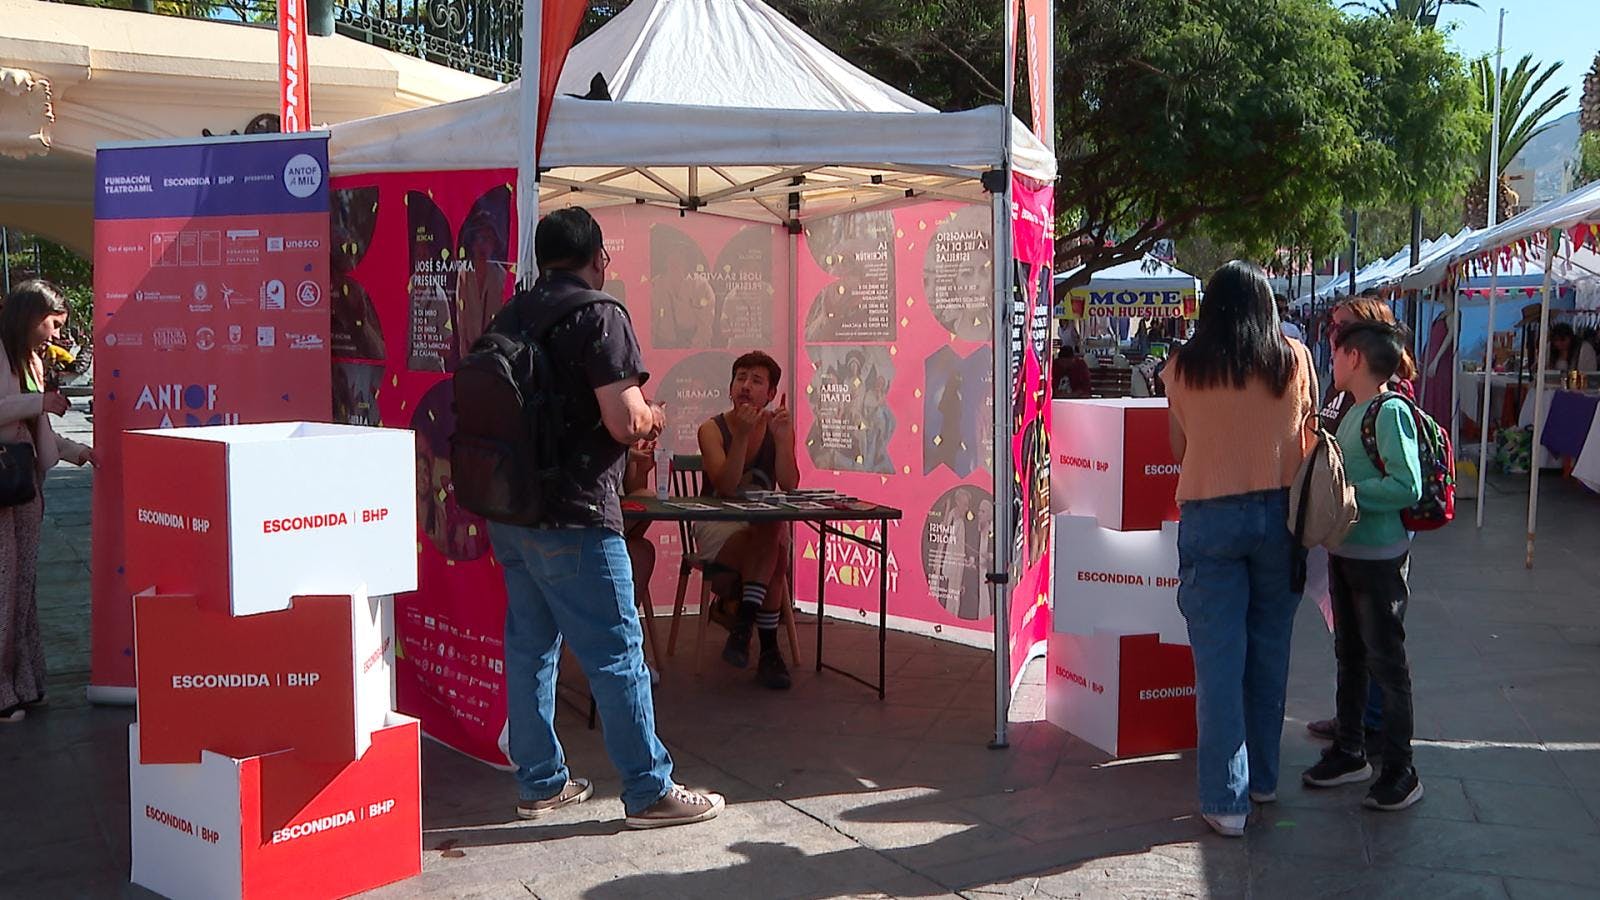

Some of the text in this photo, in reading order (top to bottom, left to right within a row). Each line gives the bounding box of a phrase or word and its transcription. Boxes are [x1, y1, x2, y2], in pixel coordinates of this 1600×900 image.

[289, 167, 317, 176] ANTOF
[104, 174, 150, 186] FUNDACIÓN
[163, 176, 235, 187] ESCONDIDA BHP
[297, 176, 316, 186] MIL
[104, 184, 153, 194] TEATROAMIL
[286, 240, 319, 248] unesco
[1088, 306, 1181, 318] CON HUESILLO
[1060, 454, 1108, 472] ESCONDIDA BHP
[138, 508, 210, 533] ESCONDIDA BHP
[263, 508, 388, 534] ESCONDIDA BHP
[1077, 571, 1179, 588] ESCONDIDA BHP
[172, 673, 320, 689] ESCONDIDA BHP
[1055, 665, 1104, 695] ESCONDIDA BHP
[145, 805, 219, 845] ESCONDIDA BHP
[272, 799, 395, 845] ESCONDIDA BHP
